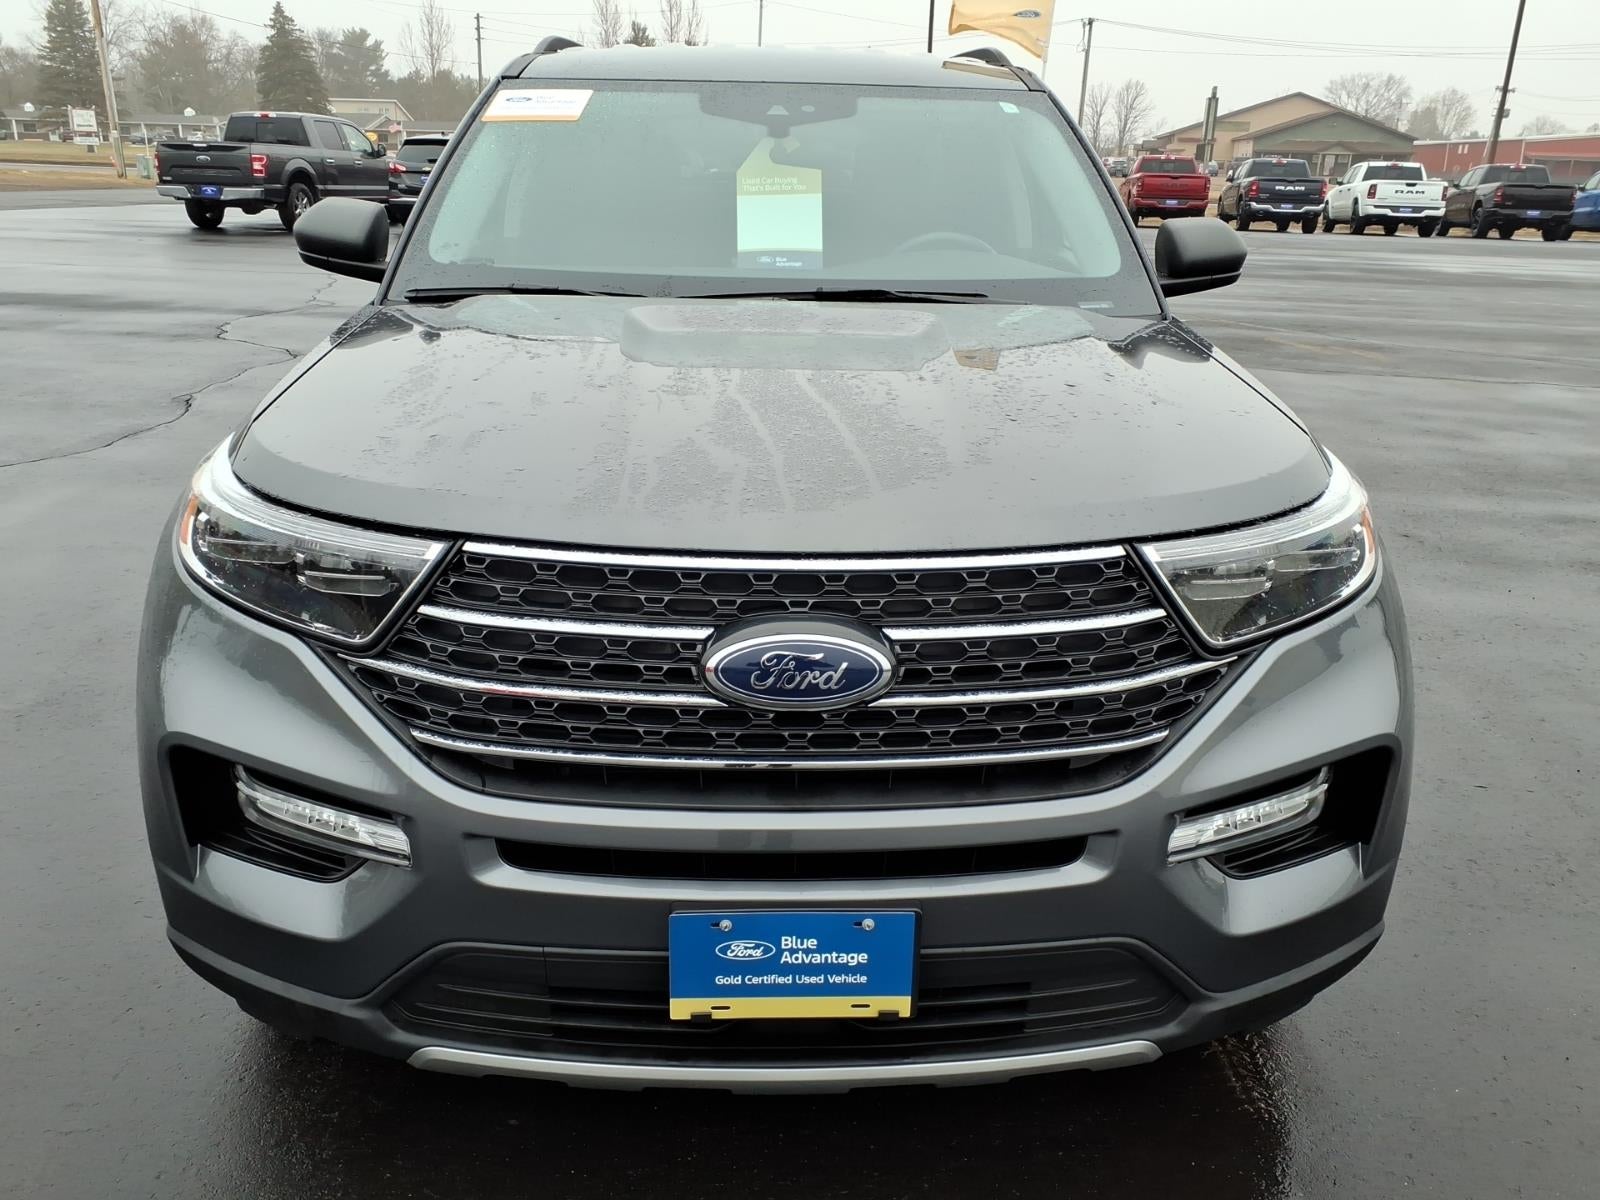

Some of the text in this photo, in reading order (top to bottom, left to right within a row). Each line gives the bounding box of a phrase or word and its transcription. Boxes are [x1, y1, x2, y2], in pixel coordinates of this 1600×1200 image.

[751, 651, 848, 690] Ford
[726, 942, 764, 958] Ford
[781, 936, 818, 949] Blue
[780, 951, 868, 966] Advantage
[715, 974, 867, 985] Gold Certified Used Vehicle
